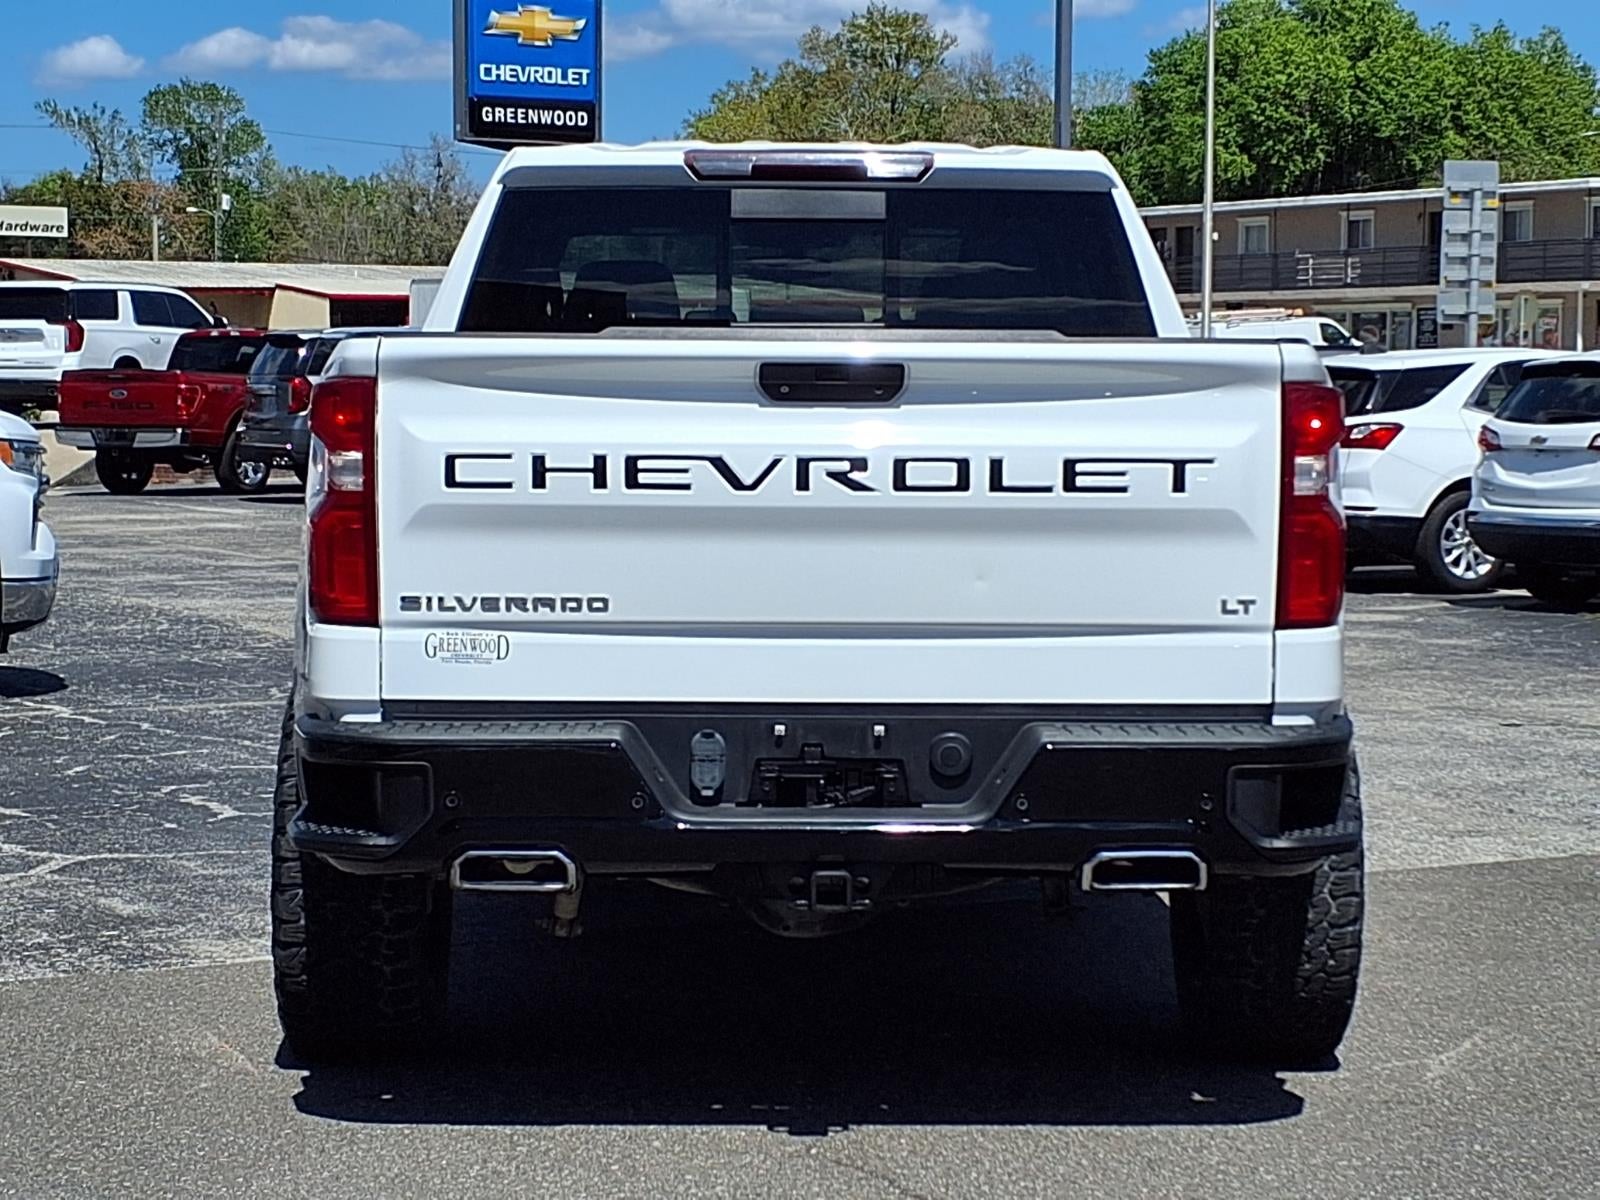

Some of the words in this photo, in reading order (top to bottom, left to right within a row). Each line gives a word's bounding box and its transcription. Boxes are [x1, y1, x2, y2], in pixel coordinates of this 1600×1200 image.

[480, 64, 591, 86] CHEVROLET
[482, 106, 588, 126] GREENWOOD
[445, 453, 1215, 495] CHEVROLET
[400, 595, 609, 613] SILVERADO
[1221, 599, 1257, 615] LT
[424, 632, 510, 660] GREENWOOD
